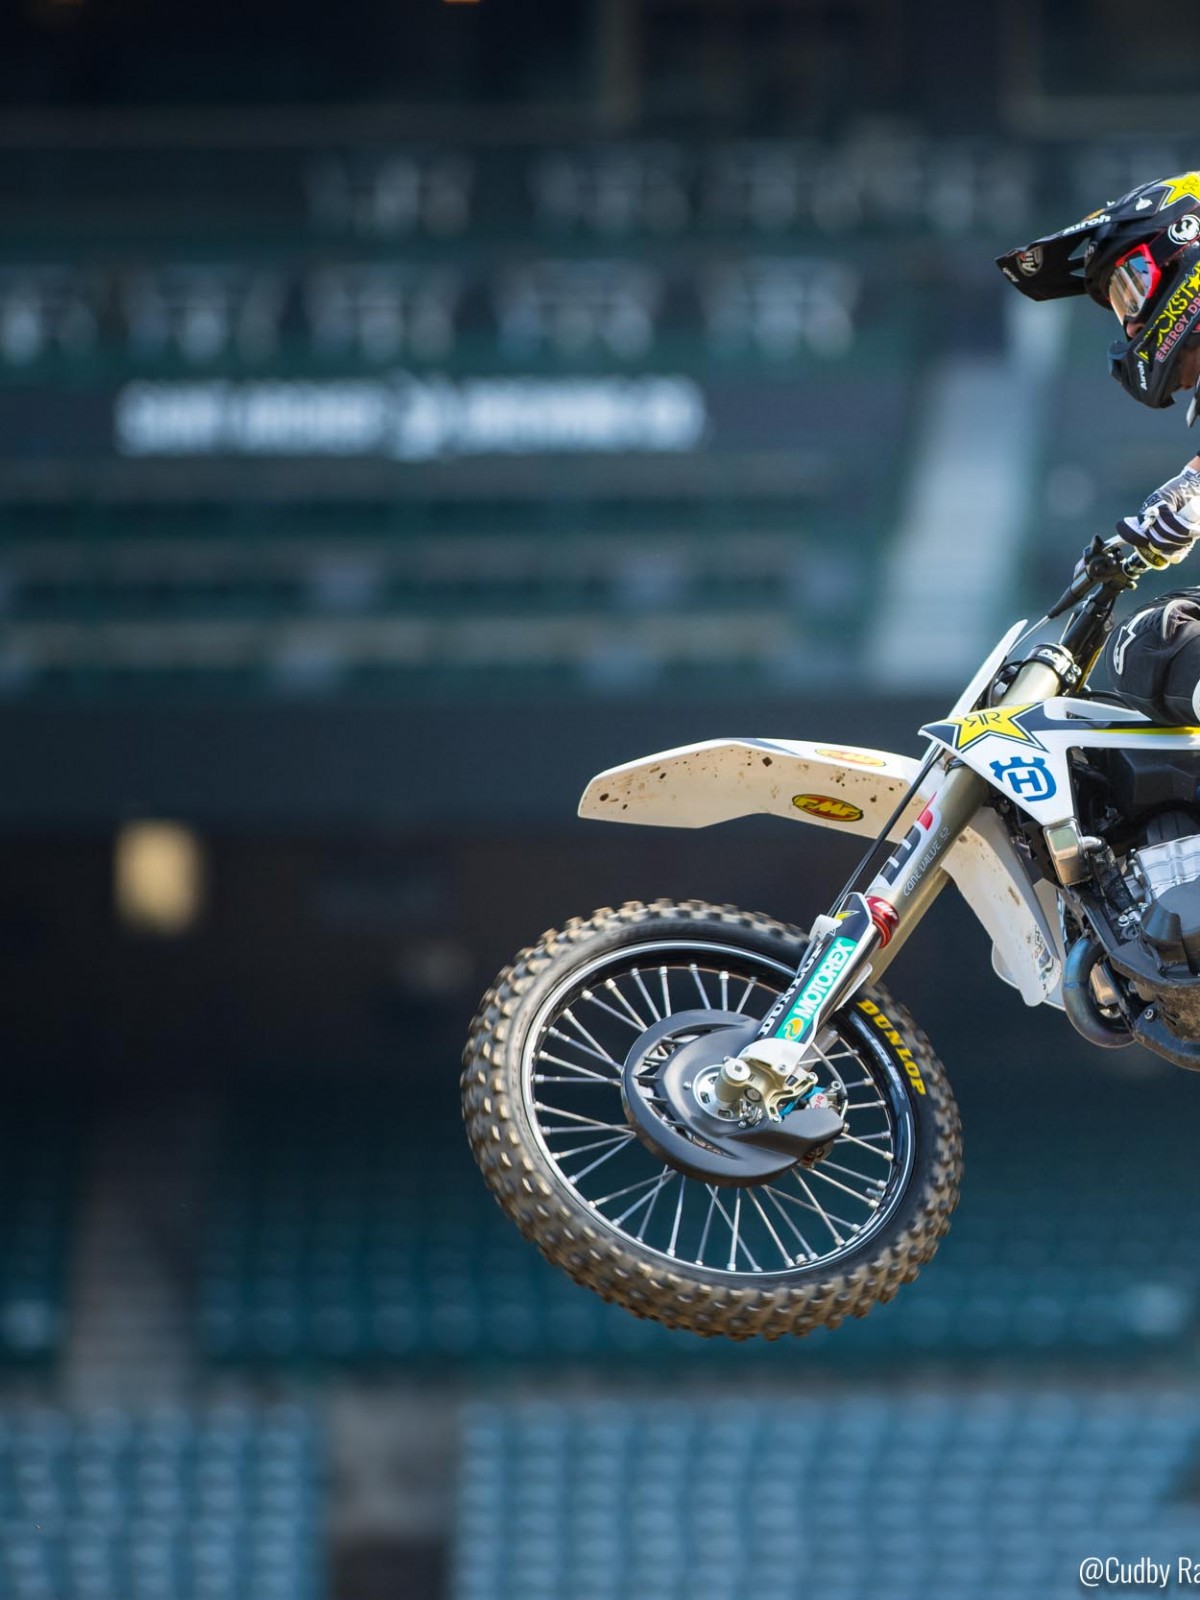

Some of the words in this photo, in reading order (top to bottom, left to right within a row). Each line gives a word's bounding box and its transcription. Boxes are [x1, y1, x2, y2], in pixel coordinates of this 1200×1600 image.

[1155, 313, 1190, 361] ENERGY
[792, 939, 855, 1020] MOTOREX
[856, 998, 927, 1096] DUNLOP
